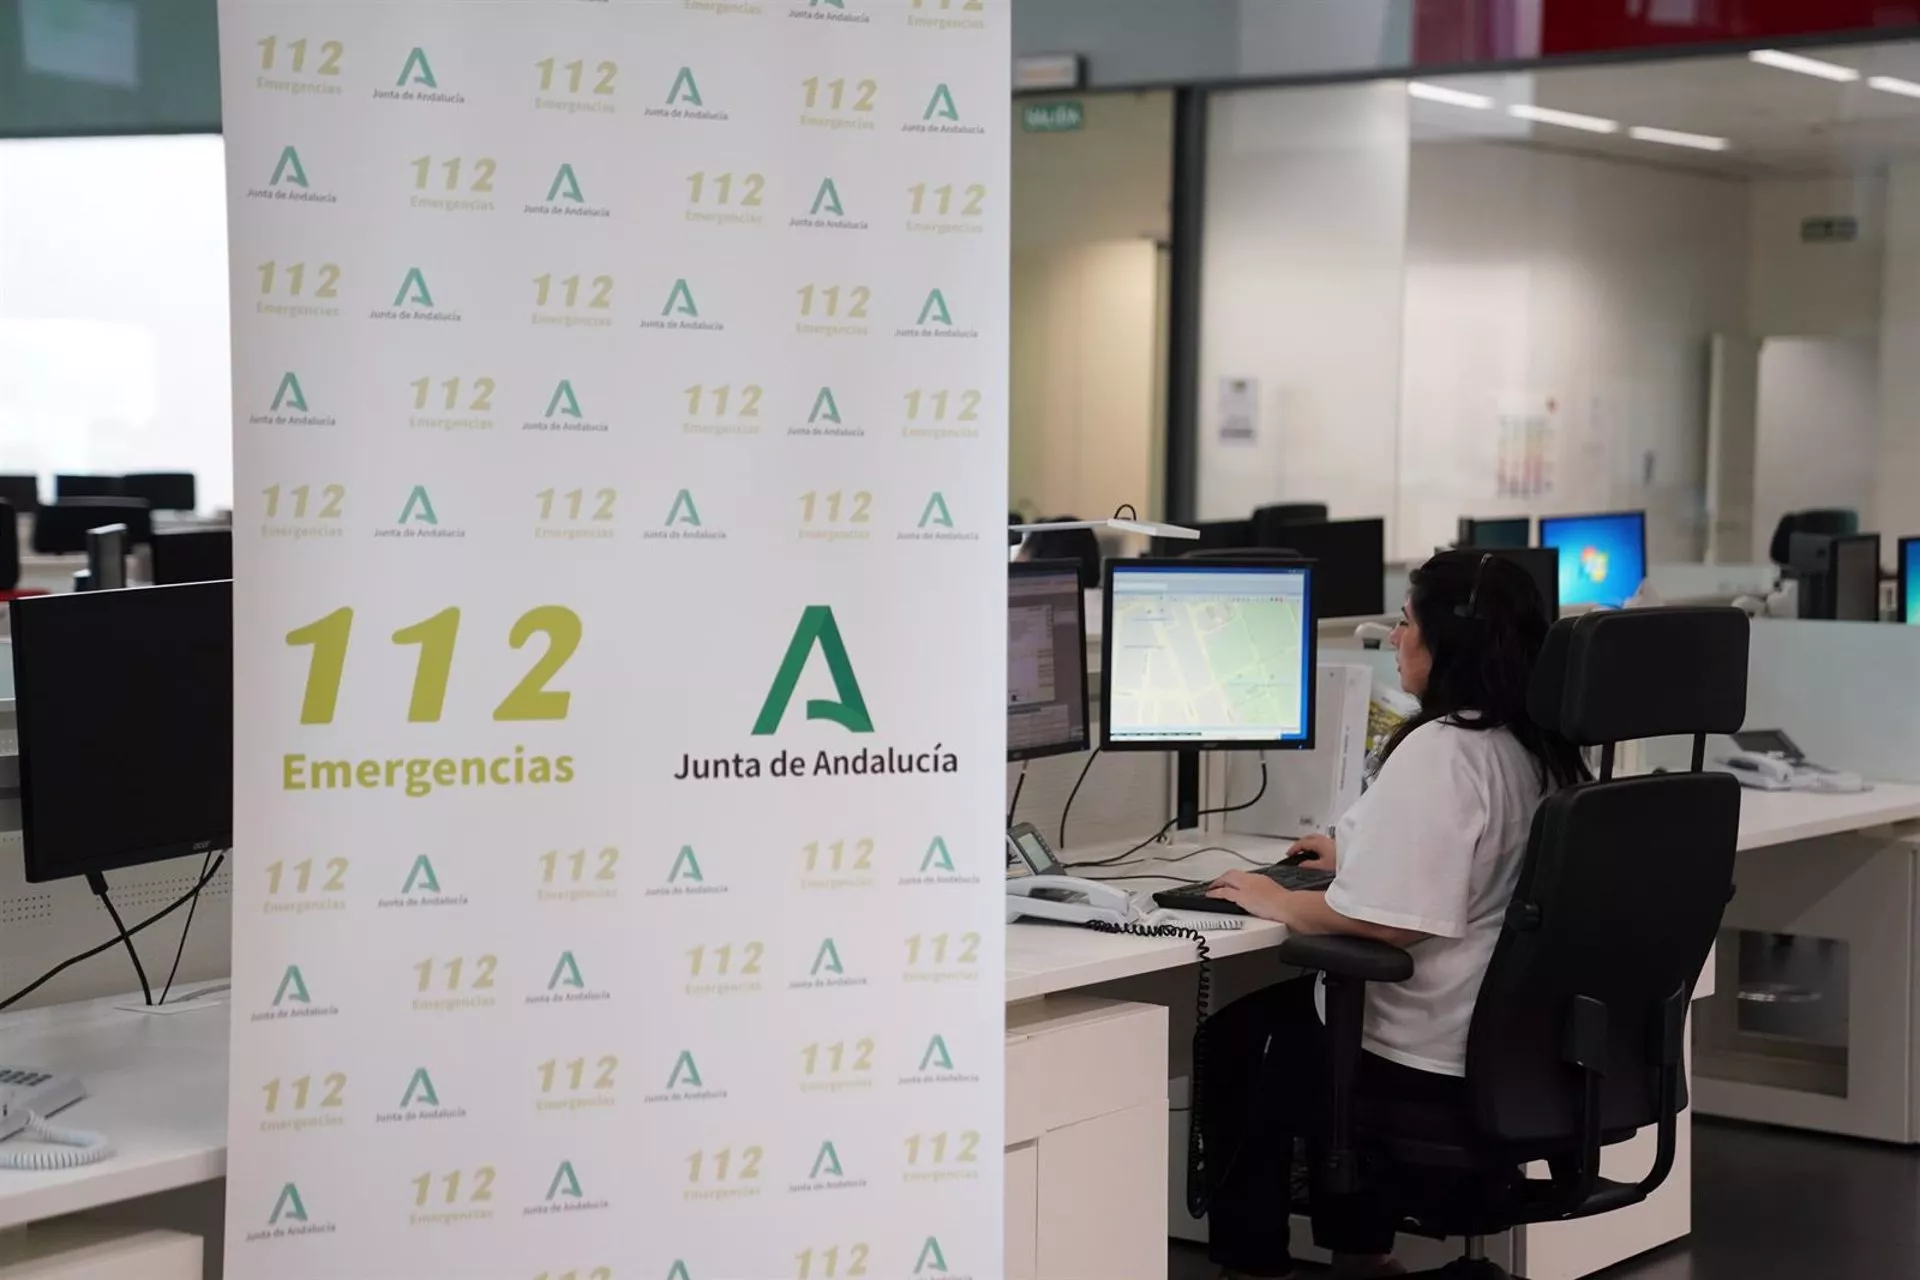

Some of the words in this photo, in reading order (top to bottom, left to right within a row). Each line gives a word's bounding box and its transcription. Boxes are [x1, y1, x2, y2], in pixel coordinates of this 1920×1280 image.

[258, 36, 344, 76] 112
[536, 58, 619, 95] 112
[802, 76, 877, 112] 112
[411, 156, 496, 194] 112
[687, 172, 765, 207] 112
[907, 182, 987, 216] 112
[257, 260, 341, 299] 112
[533, 274, 613, 309] 112
[797, 284, 871, 319] 112
[411, 377, 496, 412] 112
[683, 384, 763, 417] 112
[904, 389, 981, 421] 112
[262, 484, 346, 518] 112
[537, 488, 618, 521] 112
[799, 490, 873, 524] 112
[285, 604, 582, 725] 112
[751, 605, 875, 735] A
[283, 745, 574, 798] Emergencias
[673, 754, 761, 780] Junta
[770, 750, 806, 777] de
[813, 743, 958, 775] Andalucía
[539, 846, 620, 883] 112
[803, 838, 875, 872] 112
[265, 856, 349, 895] 112
[688, 941, 764, 976] 112
[904, 932, 980, 967] 112
[416, 954, 497, 991] 112
[538, 1055, 619, 1093] 112
[801, 1037, 875, 1075] 112
[262, 1072, 347, 1112] 112
[688, 1145, 764, 1184] 112
[903, 1131, 979, 1165] 112
[412, 1164, 496, 1206] 112
